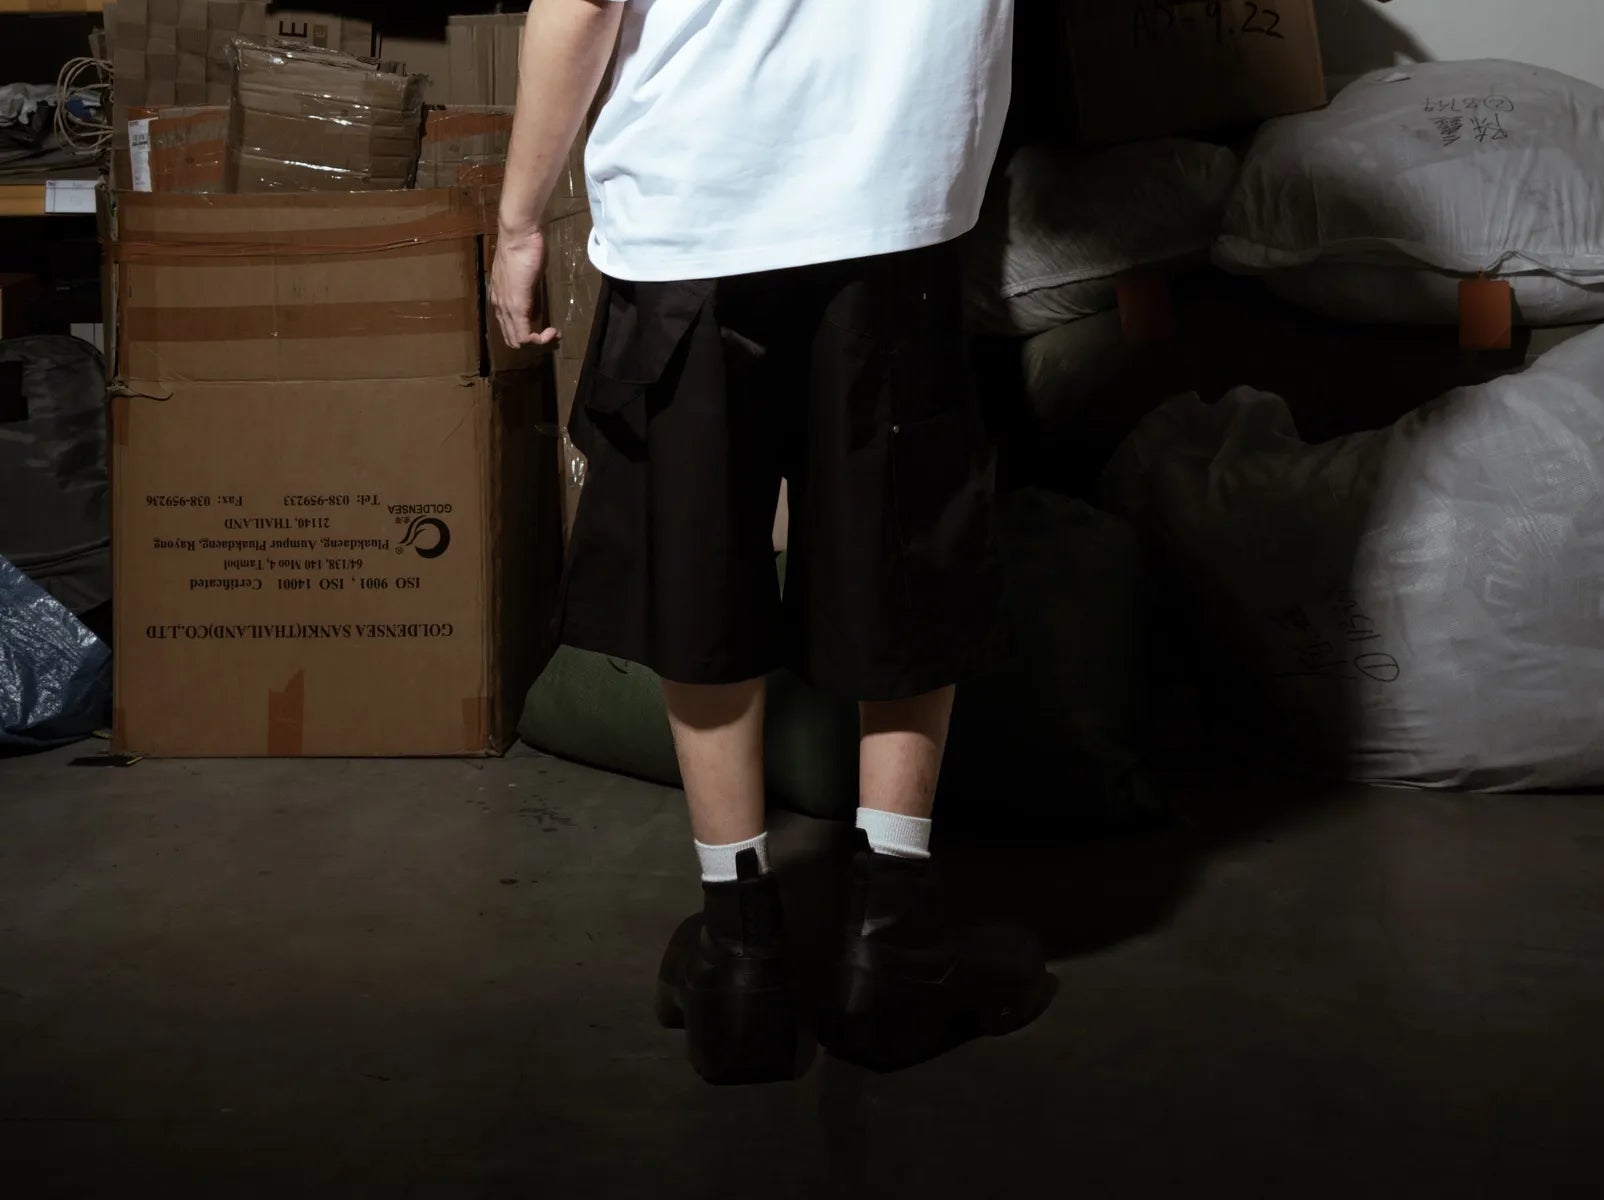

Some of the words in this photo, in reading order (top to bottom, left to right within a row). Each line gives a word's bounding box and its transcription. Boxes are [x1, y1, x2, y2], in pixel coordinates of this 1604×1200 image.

[218, 496, 242, 506] Fax:
[356, 495, 379, 505] Tel:
[388, 504, 452, 514] GOLDENSEA
[224, 519, 291, 529] THAILAND
[153, 538, 195, 551] Rayong
[270, 538, 316, 549] Aumpur
[224, 560, 264, 570] Tambol
[279, 560, 300, 569] Moo
[305, 560, 321, 569] 140
[190, 579, 262, 590] Certificated
[278, 579, 311, 589] 14001
[319, 578, 344, 589] ISO
[396, 577, 420, 589] ISO
[355, 623, 453, 638] GOLDENSEA
